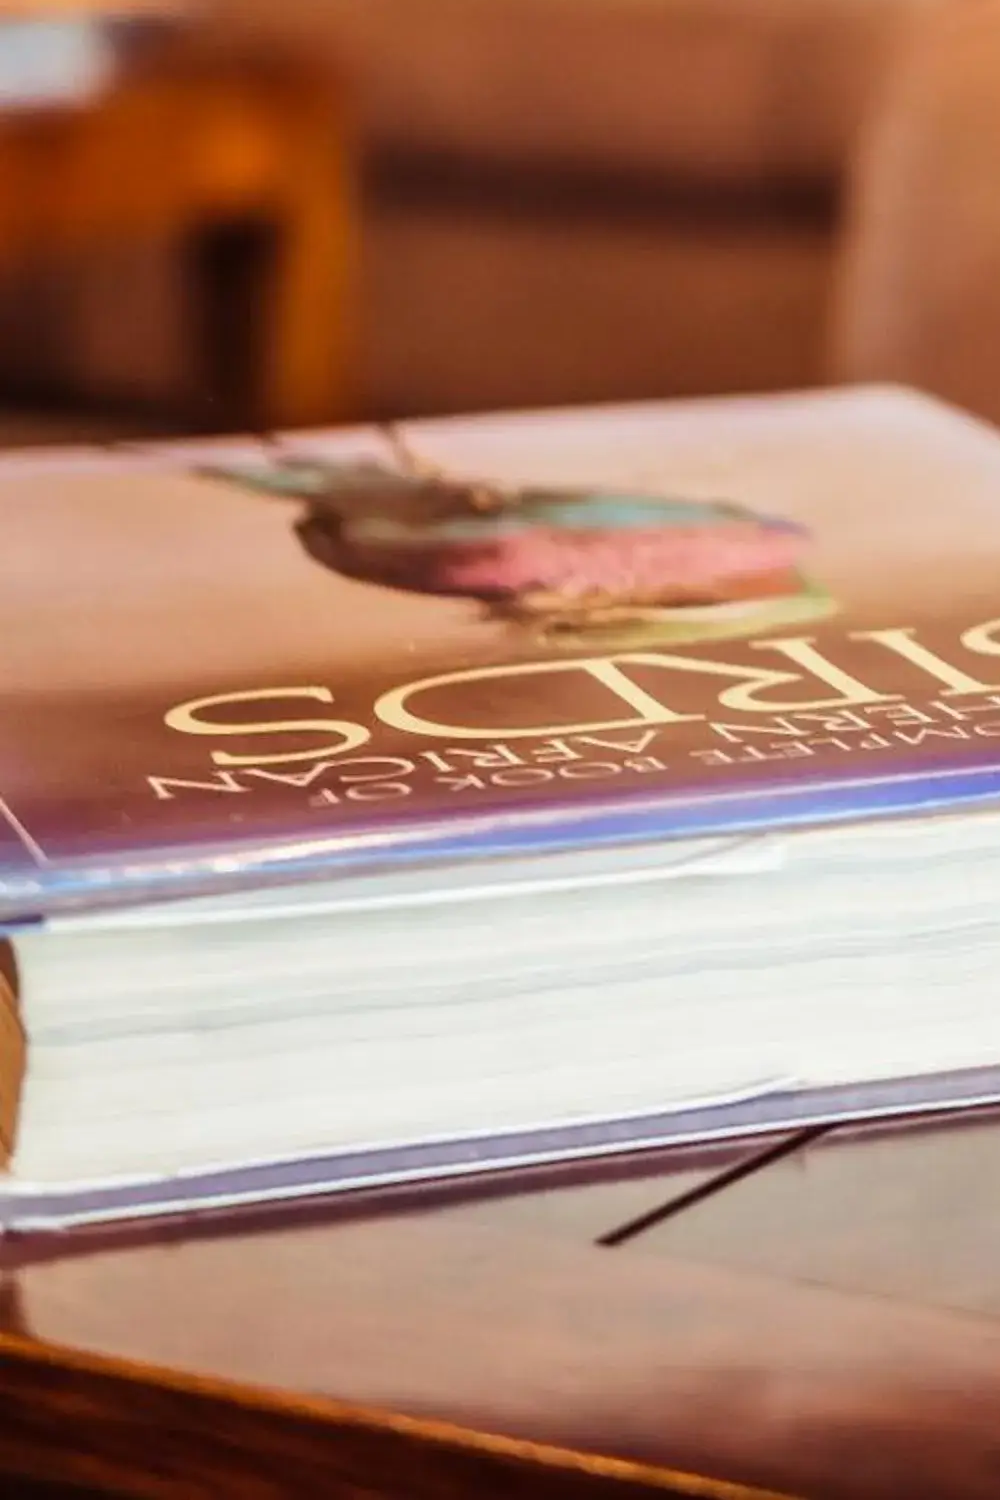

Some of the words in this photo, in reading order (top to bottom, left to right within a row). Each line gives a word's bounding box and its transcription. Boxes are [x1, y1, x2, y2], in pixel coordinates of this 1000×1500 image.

[147, 729, 661, 800] AFRICAN
[436, 756, 668, 793] BOOK
[309, 782, 412, 807] OF
